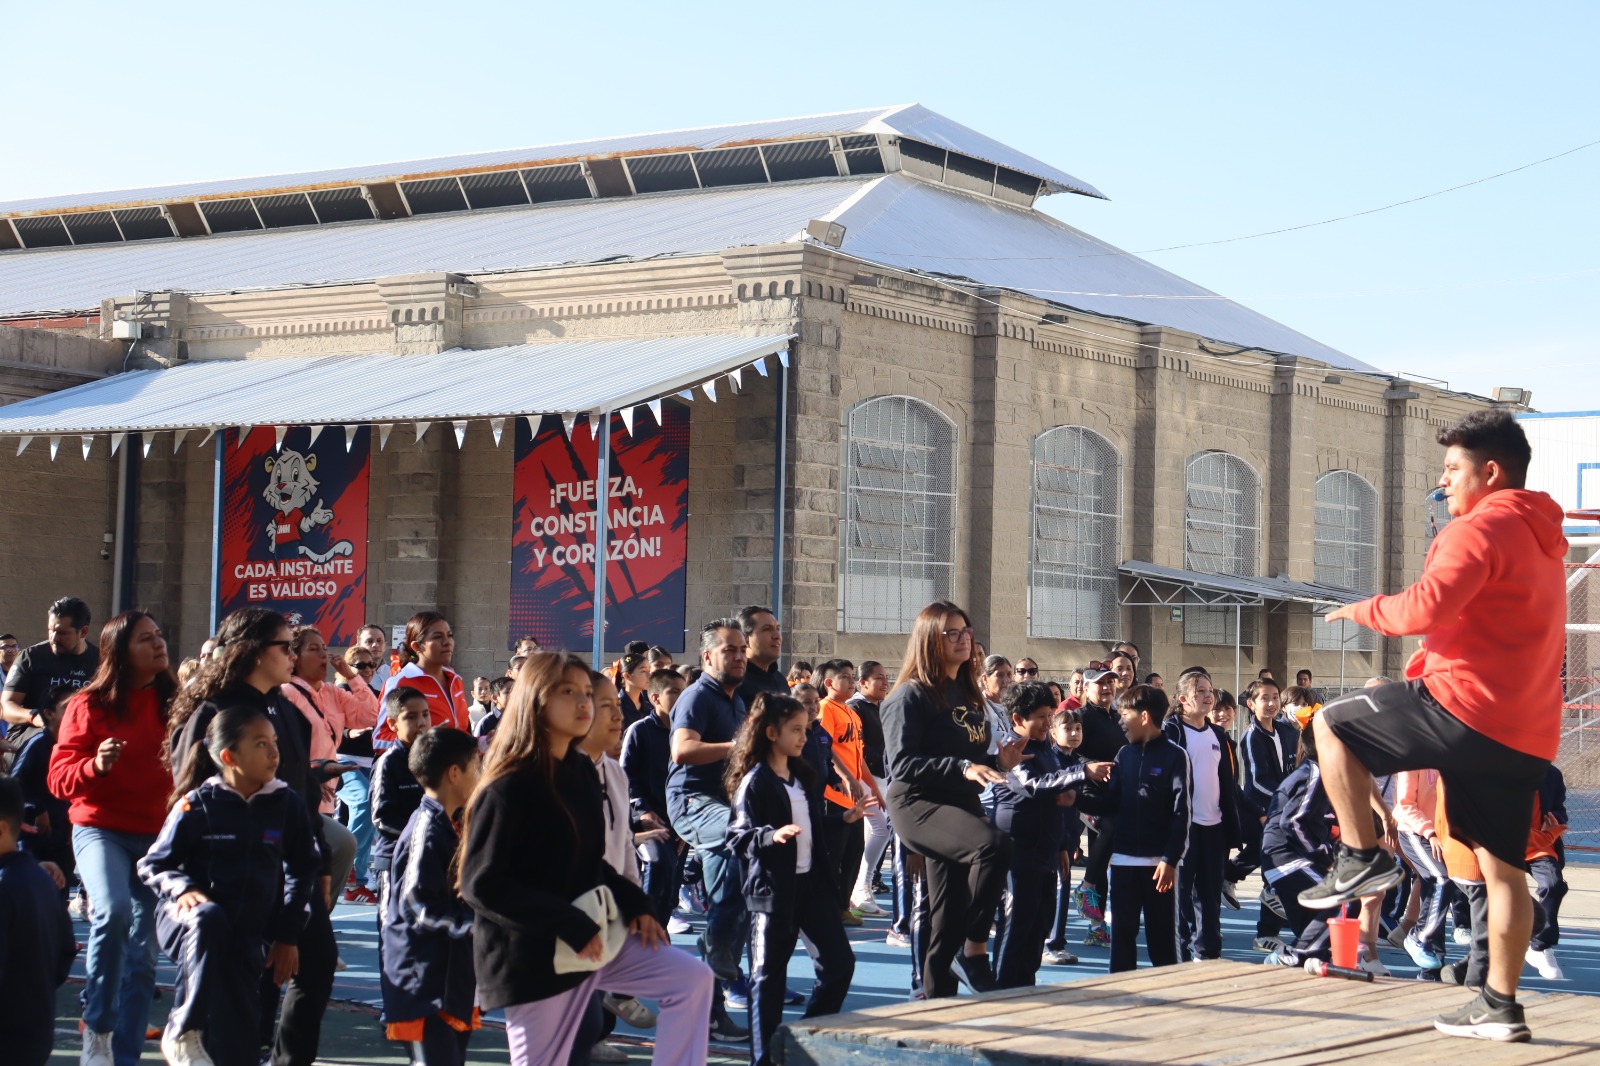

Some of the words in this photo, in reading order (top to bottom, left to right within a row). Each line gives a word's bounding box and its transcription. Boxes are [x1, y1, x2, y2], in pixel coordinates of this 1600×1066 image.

[550, 476, 643, 508] ¡FUEZA,
[534, 547, 547, 568] Y
[234, 562, 277, 579] CADA
[280, 559, 353, 577] INSTANTE
[249, 583, 267, 599] ES
[270, 581, 337, 597] VALIOSO
